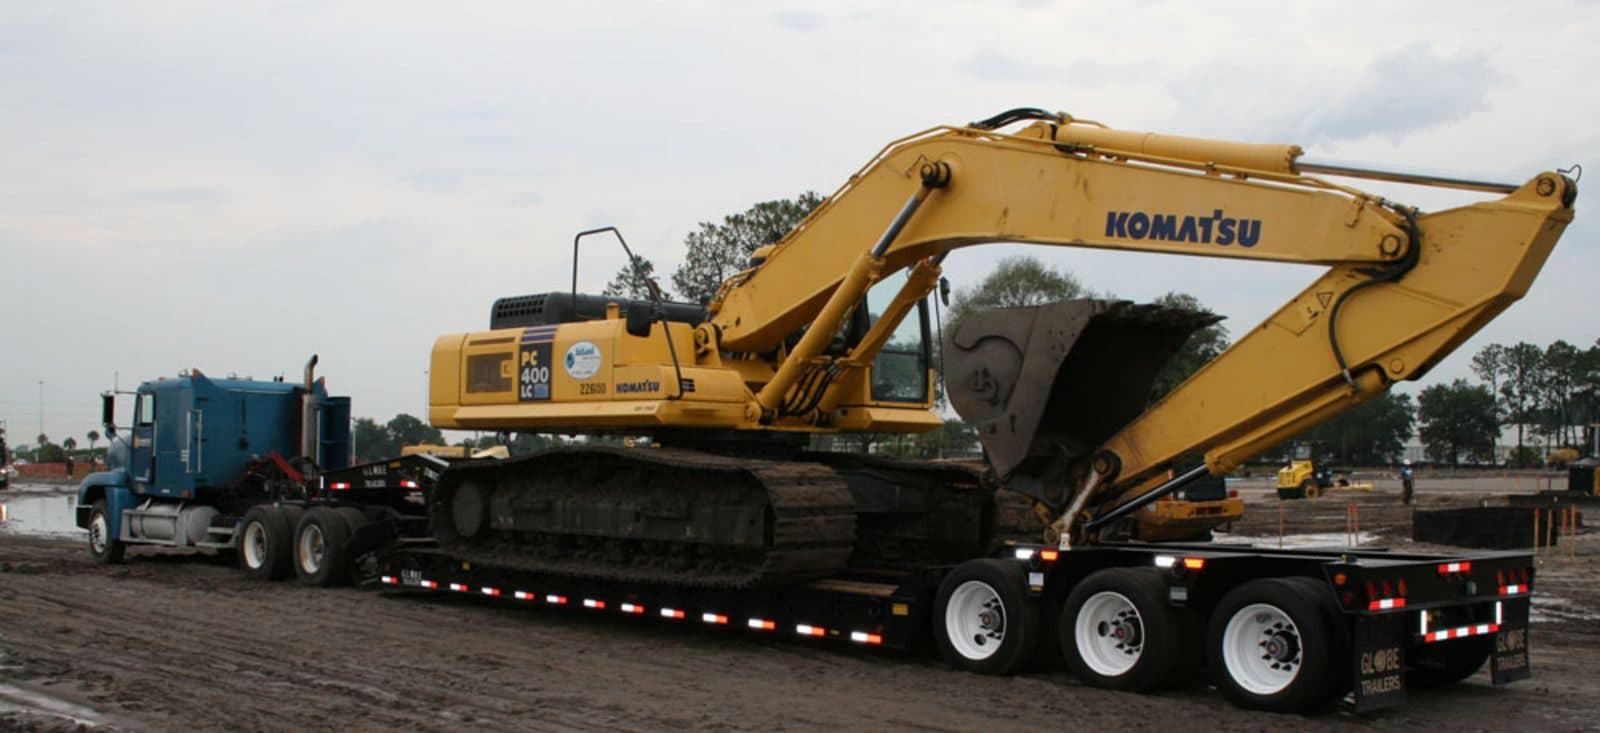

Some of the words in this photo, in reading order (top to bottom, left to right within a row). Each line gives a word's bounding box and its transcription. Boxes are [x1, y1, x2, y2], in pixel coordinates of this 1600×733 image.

[1105, 209, 1262, 247] KOMATSU
[521, 351, 538, 366] PC
[521, 367, 549, 384] 400
[521, 384, 533, 398] LC
[616, 379, 661, 393] KOMATSU
[1360, 675, 1401, 696] TRAILERS
